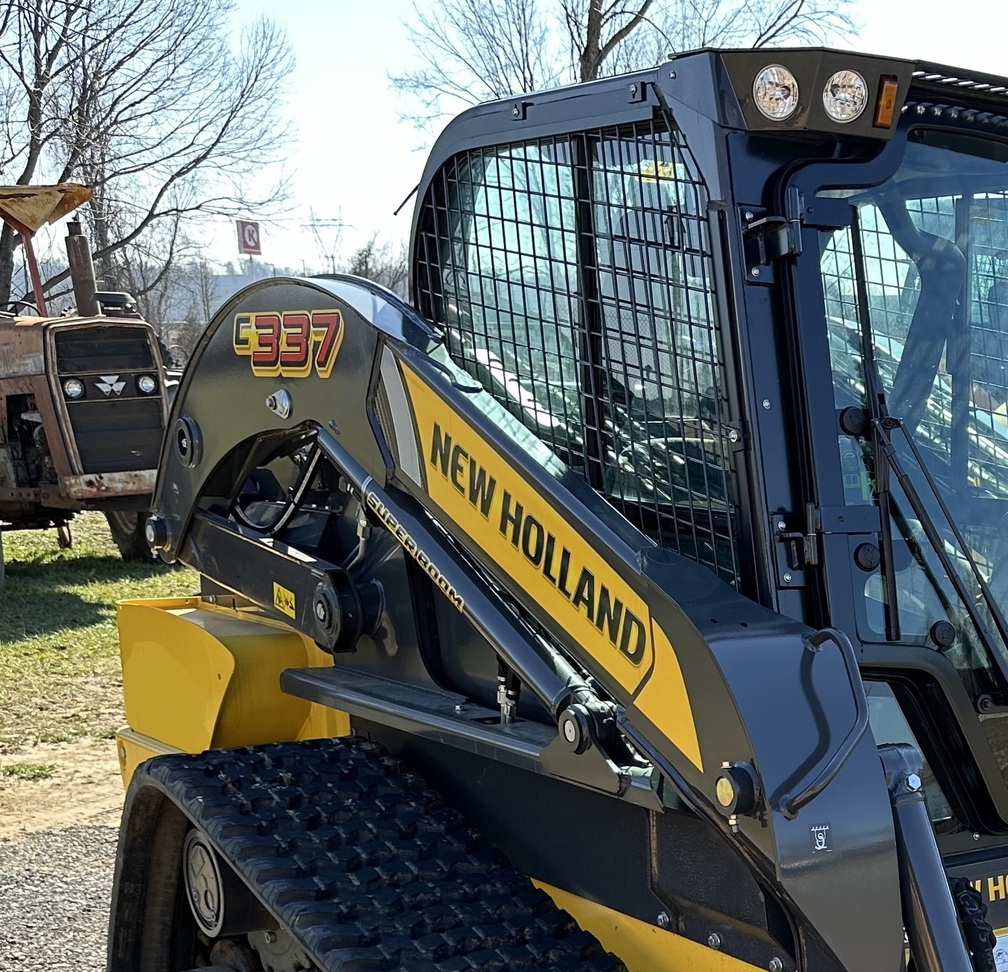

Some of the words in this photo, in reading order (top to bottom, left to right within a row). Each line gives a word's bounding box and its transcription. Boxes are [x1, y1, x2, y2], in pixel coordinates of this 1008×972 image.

[234, 309, 343, 378] C337
[430, 421, 497, 521] NEW
[499, 489, 647, 667] HOLLAND
